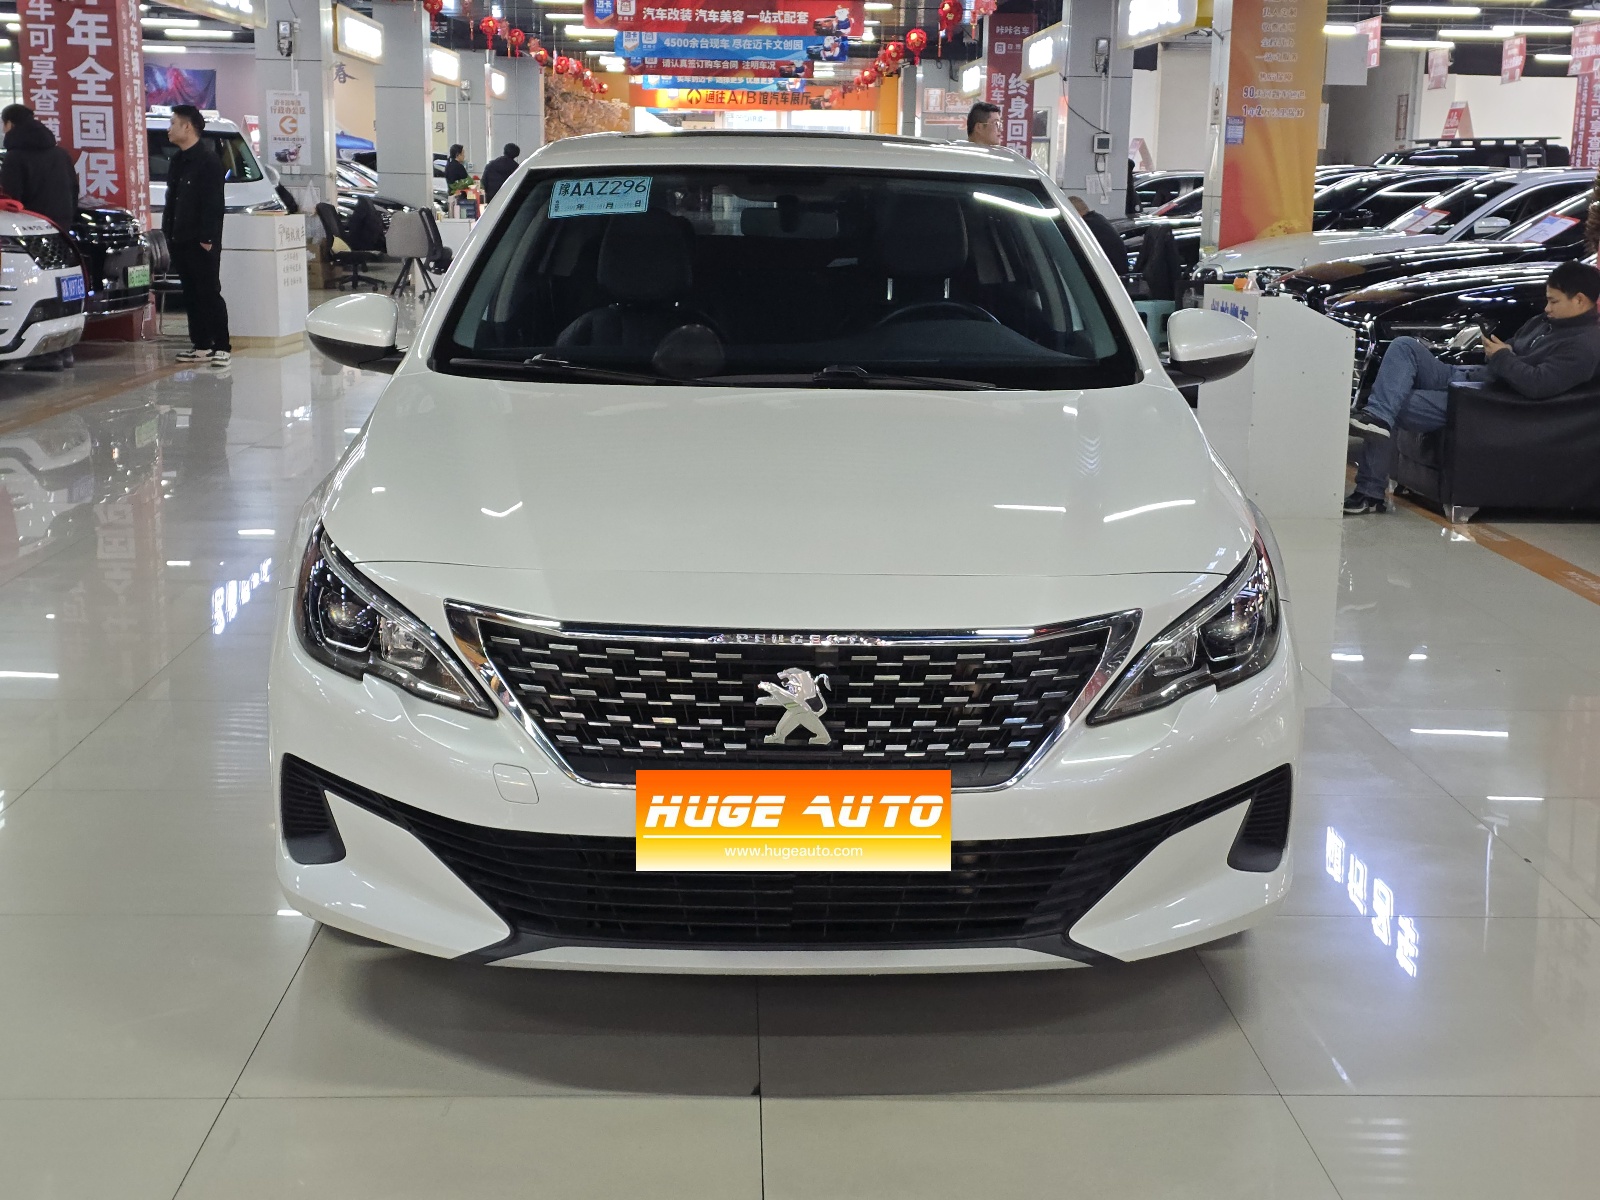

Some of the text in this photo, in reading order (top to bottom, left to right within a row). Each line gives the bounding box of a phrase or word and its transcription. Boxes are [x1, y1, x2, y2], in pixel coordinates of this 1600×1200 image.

[643, 7, 811, 26] 汽车改装 汽车美容 一站式配套
[664, 38, 804, 52] 4500余台现车 尽在迈卡文创园
[334, 62, 358, 83] 春
[662, 59, 776, 71] 请认真签订购车合同 注明车况
[67, 0, 119, 197] 年全国保
[559, 180, 647, 197] 豫AAZ296
[634, 199, 642, 207] 日
